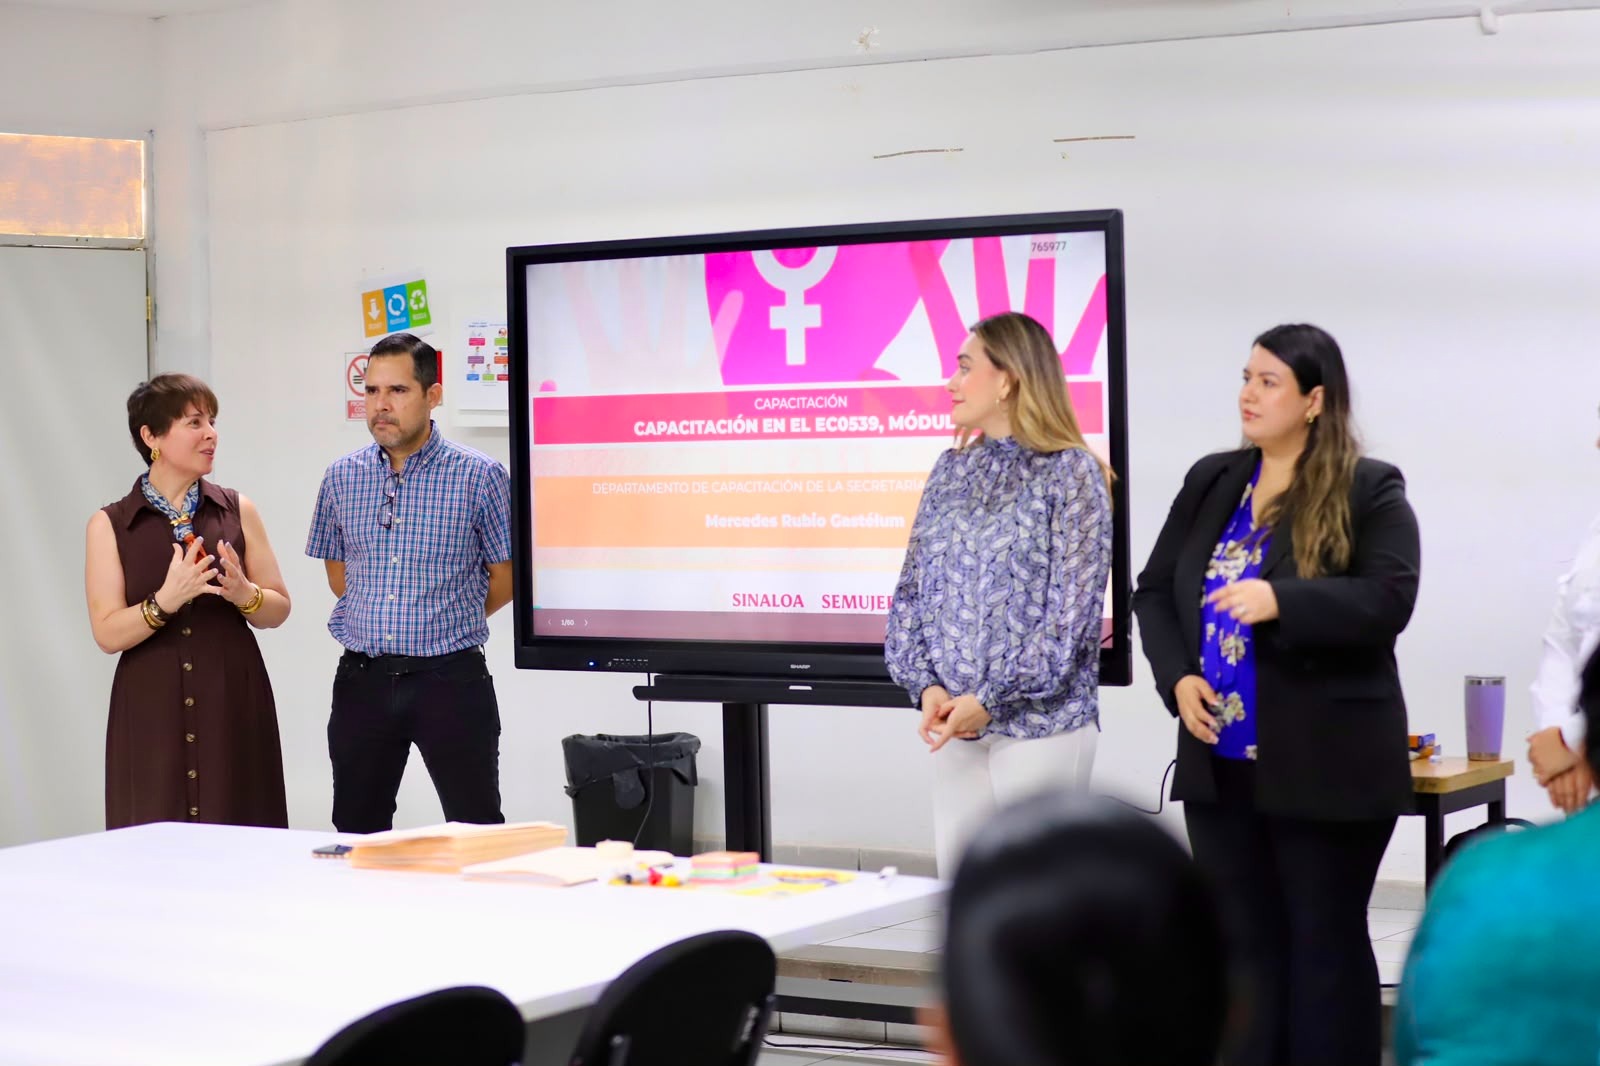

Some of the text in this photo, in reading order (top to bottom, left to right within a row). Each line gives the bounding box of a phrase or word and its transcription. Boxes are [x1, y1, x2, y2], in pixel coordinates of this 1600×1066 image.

[1031, 240, 1067, 252] 765977
[754, 393, 848, 410] CAPACITACIÓN
[633, 409, 956, 436] CAPACITACIÓN EN EL EC0539, MÓDUL
[592, 481, 689, 495] DEPARTAMENTO
[692, 481, 709, 494] DE
[711, 478, 803, 494] CAPACITACIÓN
[806, 480, 824, 493] DE
[827, 479, 844, 493] LA
[705, 511, 906, 528] Mercedes Rubio Gastélum
[732, 592, 805, 608] SINALOA
